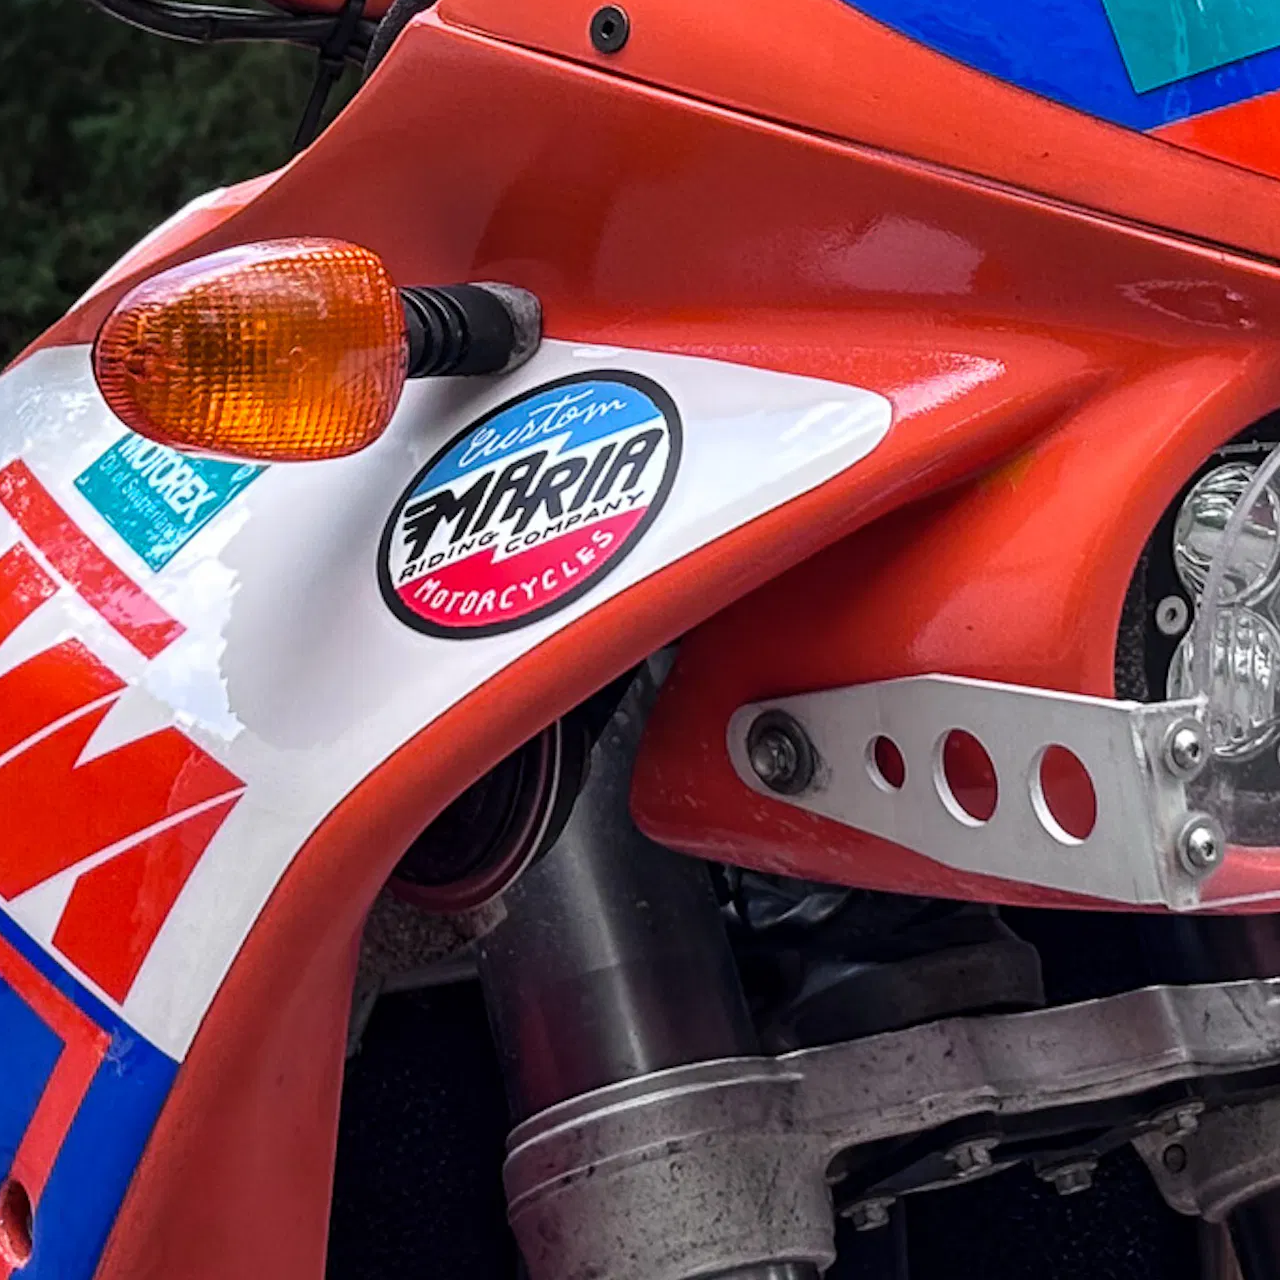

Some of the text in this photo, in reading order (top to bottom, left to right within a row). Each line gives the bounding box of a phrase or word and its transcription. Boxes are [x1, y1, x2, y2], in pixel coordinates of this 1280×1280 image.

[459, 388, 627, 468] Custom
[117, 433, 218, 524] MOTOREX
[403, 428, 665, 564] MARIA
[398, 490, 646, 582] RIDING COMPANY
[413, 529, 615, 616] MOTORCYCLES
